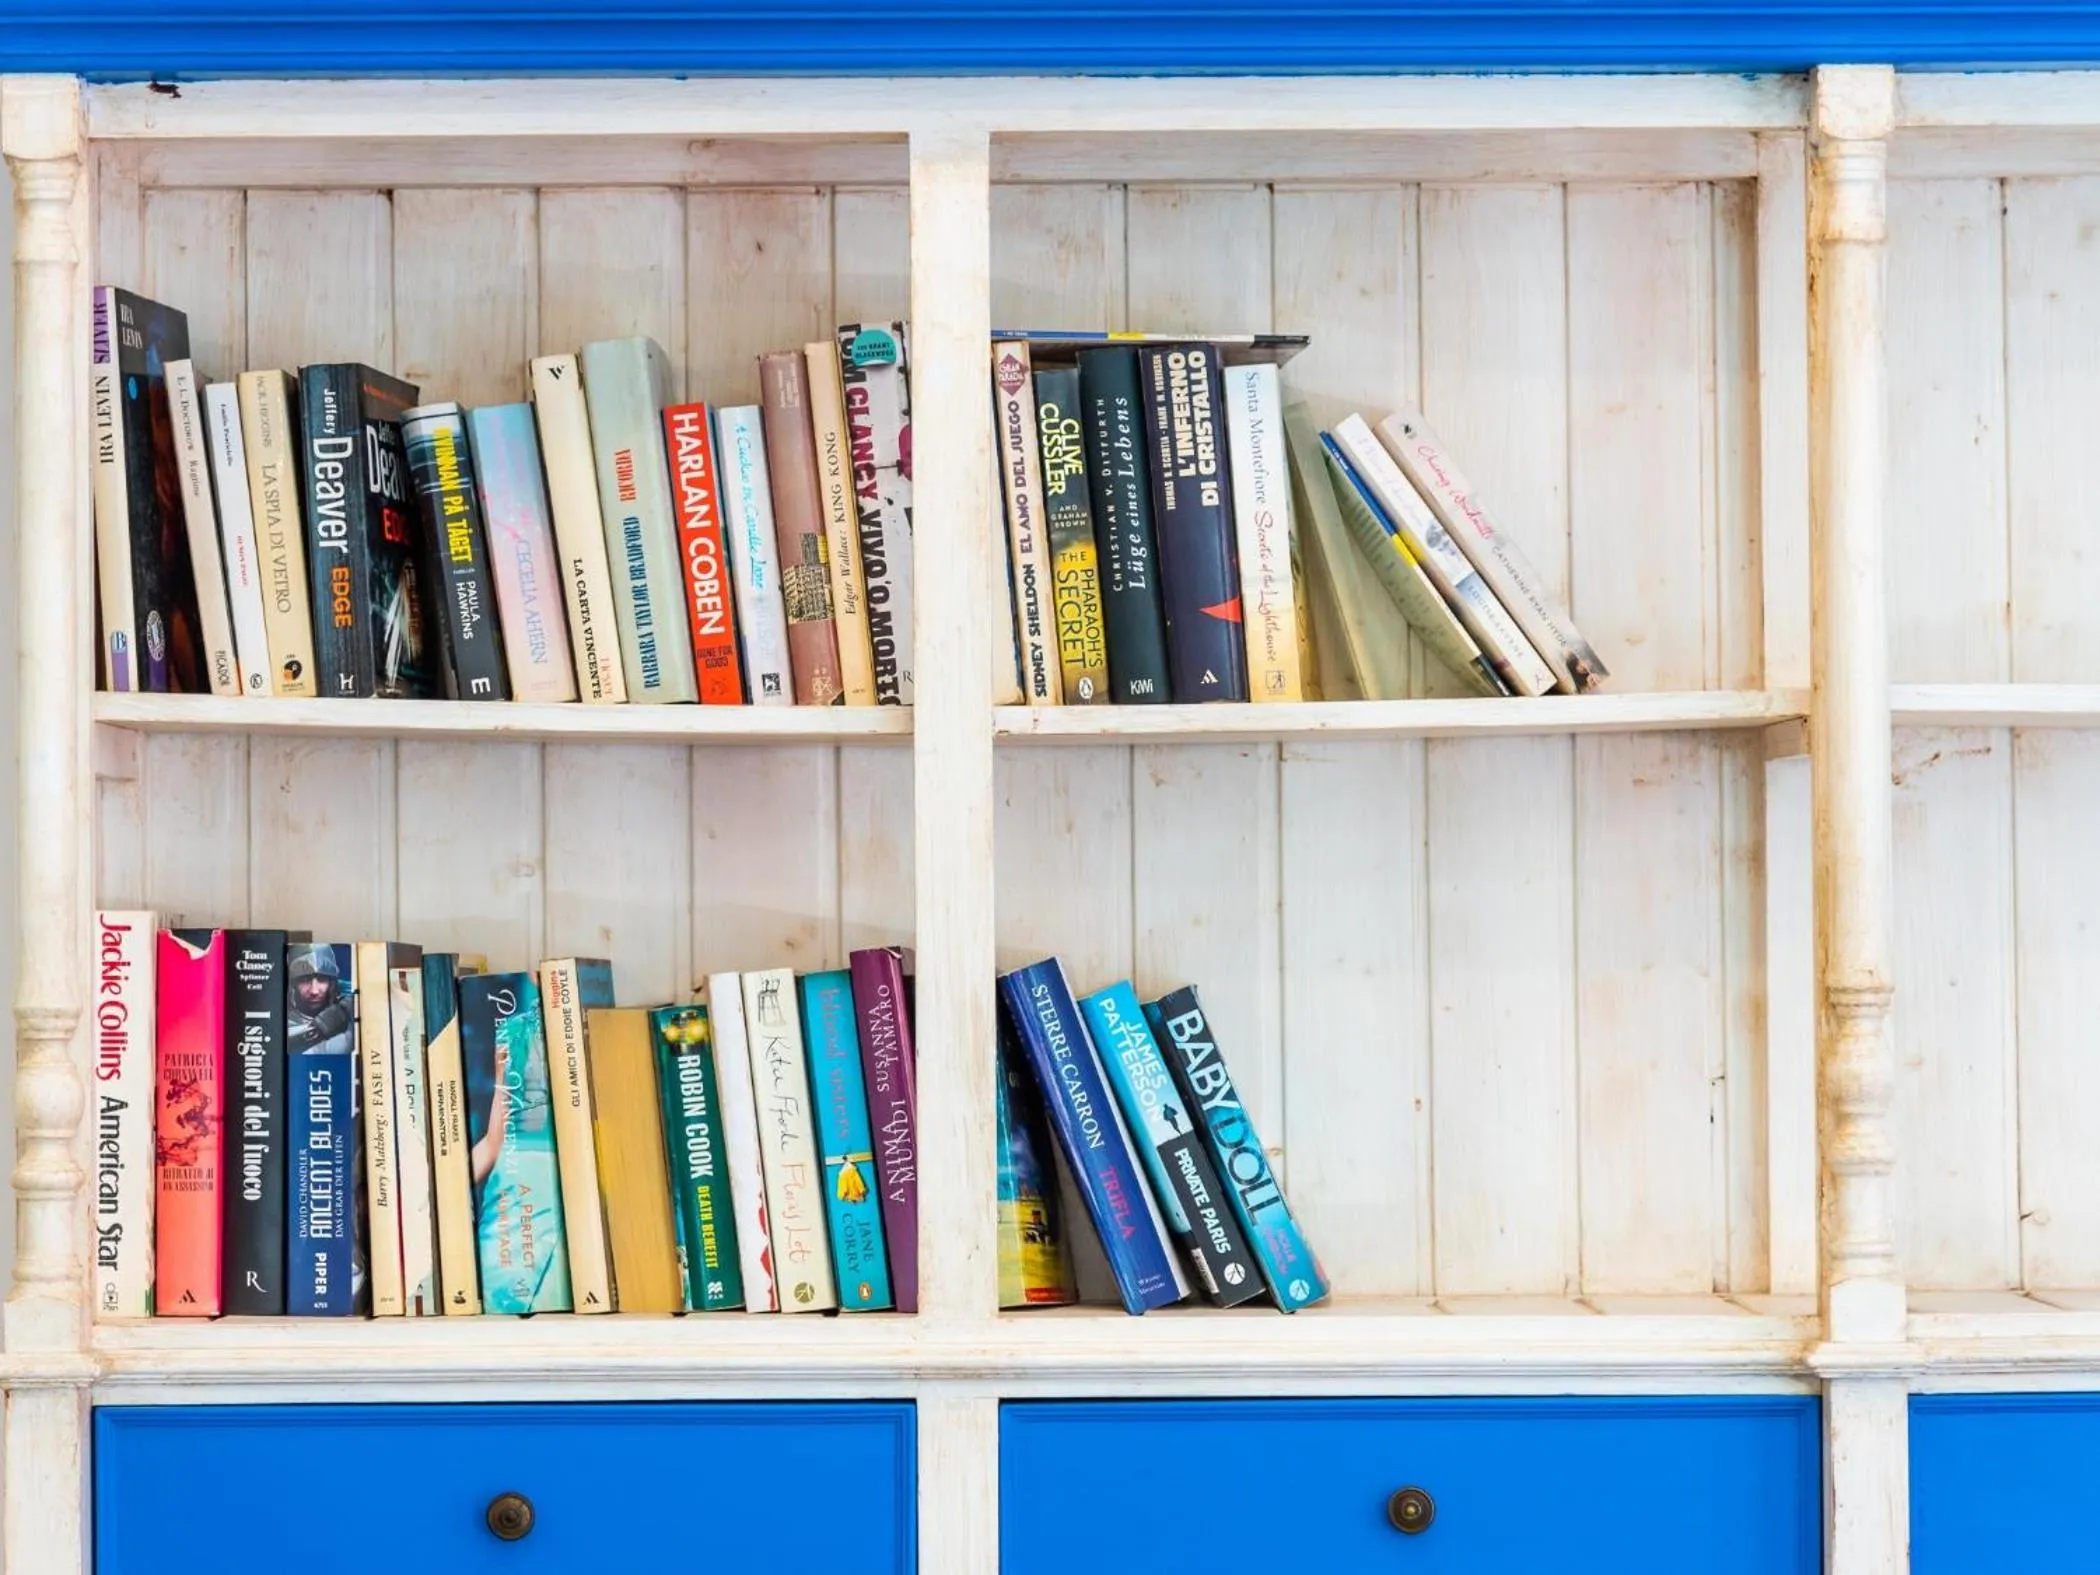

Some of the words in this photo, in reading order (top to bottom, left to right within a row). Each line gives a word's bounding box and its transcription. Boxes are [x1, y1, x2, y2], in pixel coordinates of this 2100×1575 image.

[93, 303, 111, 364] SLIVER
[96, 375, 113, 429] LEVIN
[323, 388, 337, 435] Jeffery
[1167, 351, 1197, 478] L'INFERNO
[1187, 350, 1217, 476] CRISTALLO
[1244, 371, 1260, 414] Santa
[99, 433, 114, 464] IRA
[844, 386, 880, 500] CLANCY
[1007, 400, 1024, 452] JUEGO
[1040, 402, 1067, 497] CUSSLER
[1060, 417, 1084, 476] CLIVE
[1113, 396, 1137, 478] Lebens
[262, 464, 277, 487] LA
[672, 411, 712, 530] HARLAN
[824, 431, 838, 478] KONG
[1013, 457, 1028, 488] DEL
[1249, 418, 1270, 505] Montefiore
[264, 489, 283, 528] SPIA
[313, 436, 354, 553] Deaver
[441, 495, 470, 516] PÅ
[831, 483, 846, 523] KING
[1015, 494, 1031, 530] AMO
[1059, 503, 1079, 512] AND
[1126, 483, 1140, 528] eines
[1200, 480, 1220, 507] DI
[270, 533, 286, 551] DI
[446, 518, 475, 564] TÅGET
[573, 557, 585, 576] LA
[621, 516, 647, 582] BRADFORD
[1019, 533, 1033, 554] EL
[1059, 551, 1088, 563] THE
[1107, 504, 1124, 593] CHRISTIAN
[1127, 533, 1148, 590] Lüge
[272, 553, 293, 614] VETRO
[330, 565, 354, 630] EDGE
[514, 540, 539, 606] CECELIA
[688, 537, 726, 636] COBEN
[1491, 546, 1530, 597] CATHERINE
[456, 582, 474, 640] HAWKINS
[463, 580, 482, 623] PAULA
[576, 578, 594, 626] CARTA
[629, 584, 654, 631] TAYLOR
[844, 581, 858, 616] Edgar
[1022, 563, 1041, 638] SHELDON
[1056, 569, 1088, 670] SECRET
[1080, 568, 1104, 669] PHARAOH'S
[526, 609, 549, 665] AHERN
[583, 627, 603, 699] VINCENTE
[637, 632, 661, 690] BARBARA
[1029, 641, 1048, 698] SIDNEY
[99, 913, 132, 996] Jackie
[235, 961, 275, 973] Clancy
[242, 950, 268, 960] Tom
[558, 968, 572, 1005] COYLE
[95, 1000, 129, 1082] Collins
[244, 1010, 271, 1020] I
[562, 1007, 575, 1040] EDDIE
[820, 988, 849, 1061] blood
[876, 984, 900, 1068] TAMARO
[164, 1053, 214, 1067] PATRICIA
[237, 1026, 272, 1099] signori
[371, 1050, 382, 1065] IV
[565, 1042, 576, 1054] DI
[567, 1056, 581, 1086] AMICI
[869, 1005, 891, 1093] SUSANNA
[1031, 983, 1073, 1063] STERRE
[1060, 1062, 1106, 1150] CARRON
[1099, 996, 1165, 1123] PATTERSON
[1125, 1020, 1169, 1090] JAMES
[309, 1069, 333, 1150] BLADES
[373, 1072, 384, 1106] FASE
[571, 1089, 582, 1108] GLI
[677, 1055, 708, 1118] ROBIN
[243, 1104, 271, 1137] del
[890, 1099, 916, 1183] MUNDI
[98, 1095, 129, 1215] American
[242, 1143, 271, 1201] fuoco
[299, 1148, 309, 1204] CHANDLER
[335, 1166, 344, 1187] DER
[684, 1122, 715, 1181] COOK
[309, 1157, 333, 1239] ANCIENT
[335, 1190, 344, 1217] GRAB
[377, 1176, 390, 1208] Barry
[517, 1184, 532, 1198] A
[697, 1185, 714, 1222] DEATH
[1173, 1146, 1211, 1209] PRIVATE
[1199, 1205, 1232, 1255] PARIS
[95, 1222, 123, 1273] Star
[299, 1206, 308, 1239] DAVID
[335, 1219, 344, 1238] DAS
[520, 1203, 535, 1271] PERFECT
[842, 1212, 861, 1274] CORRY
[857, 1219, 876, 1263] JANE
[246, 1269, 269, 1293] R
[314, 1252, 328, 1296] PIPER
